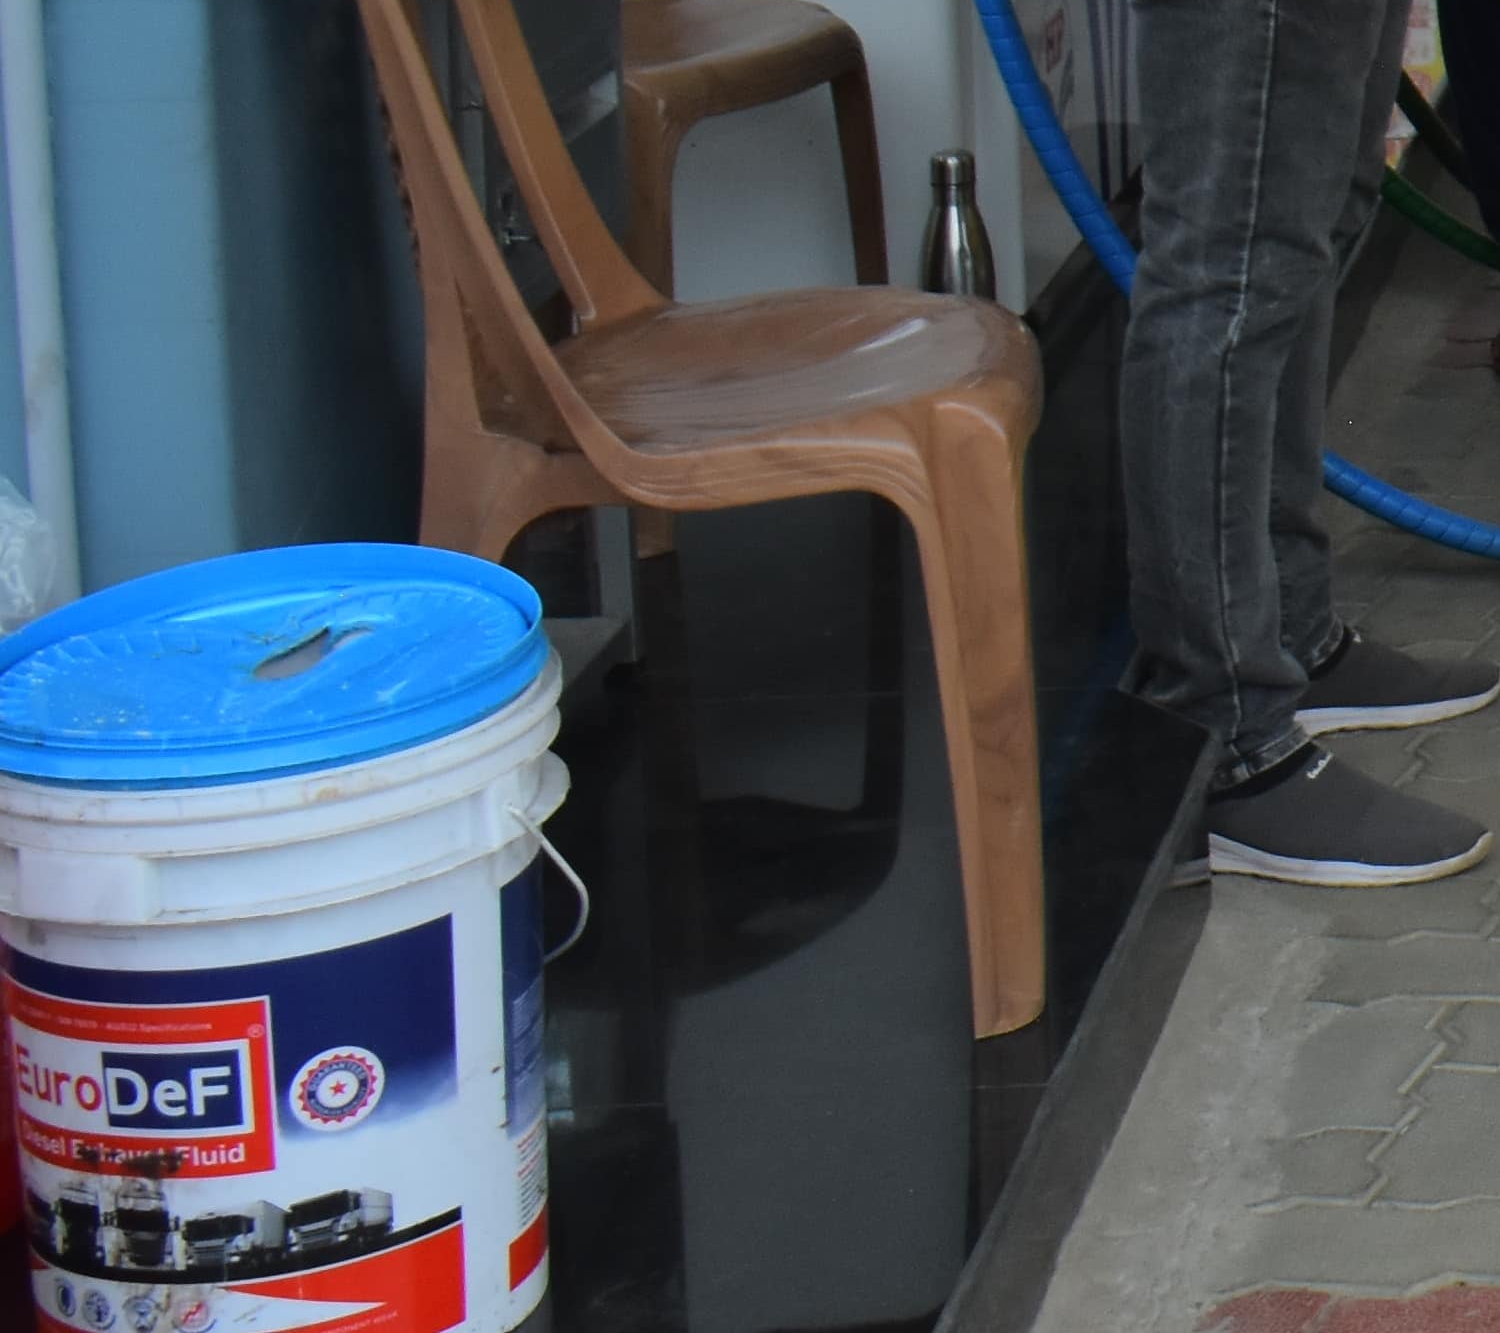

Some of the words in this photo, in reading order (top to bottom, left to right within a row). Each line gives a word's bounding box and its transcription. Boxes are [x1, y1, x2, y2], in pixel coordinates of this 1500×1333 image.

[15, 1043, 232, 1117] EuroDeF
[20, 1119, 66, 1157] Diesel
[175, 1141, 246, 1166] Fluid
